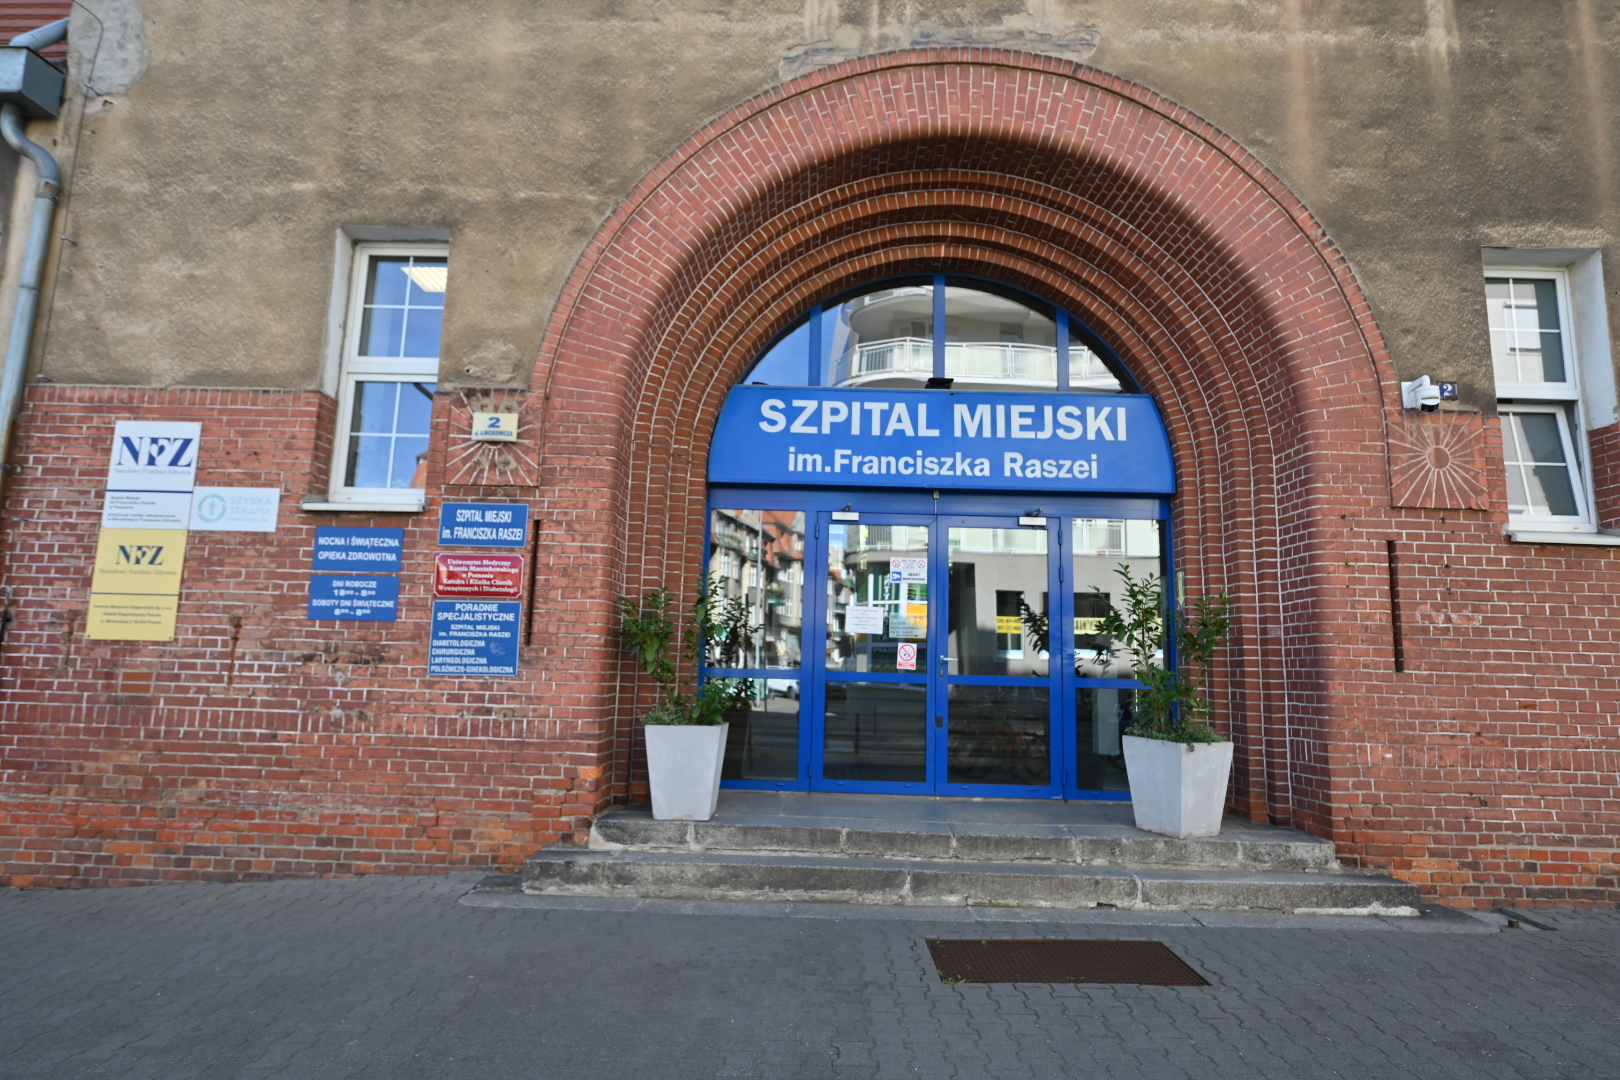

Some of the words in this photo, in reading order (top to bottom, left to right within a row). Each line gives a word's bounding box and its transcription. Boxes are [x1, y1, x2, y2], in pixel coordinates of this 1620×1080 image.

[1443, 384, 1452, 396] 2
[488, 417, 500, 428] 2
[758, 398, 940, 437] SZPITAL
[953, 403, 1127, 441] MIEJSKI
[115, 436, 194, 467] NFZ
[788, 446, 990, 477] im.Franciszka
[1004, 451, 1098, 479] Raszei
[230, 496, 272, 505] SZYBKA
[230, 506, 271, 515] TERAPIA
[456, 509, 483, 522] SZPITAL
[485, 510, 512, 523] MIEJSKI
[442, 526, 452, 538] im.
[454, 527, 497, 540] FRANCISZKA
[498, 528, 523, 541] RASZEI
[318, 537, 345, 546] NOCNA
[351, 536, 399, 548] ŚWIĄTECZNA
[115, 545, 164, 565] NFZ
[318, 551, 346, 560] OPIEKA
[348, 552, 397, 561] ZDROWOTNA
[353, 599, 394, 608] ŚWIĄTECZNE
[455, 603, 498, 612] PORADNIE
[437, 612, 515, 621] SPECJALISTYCZNE
